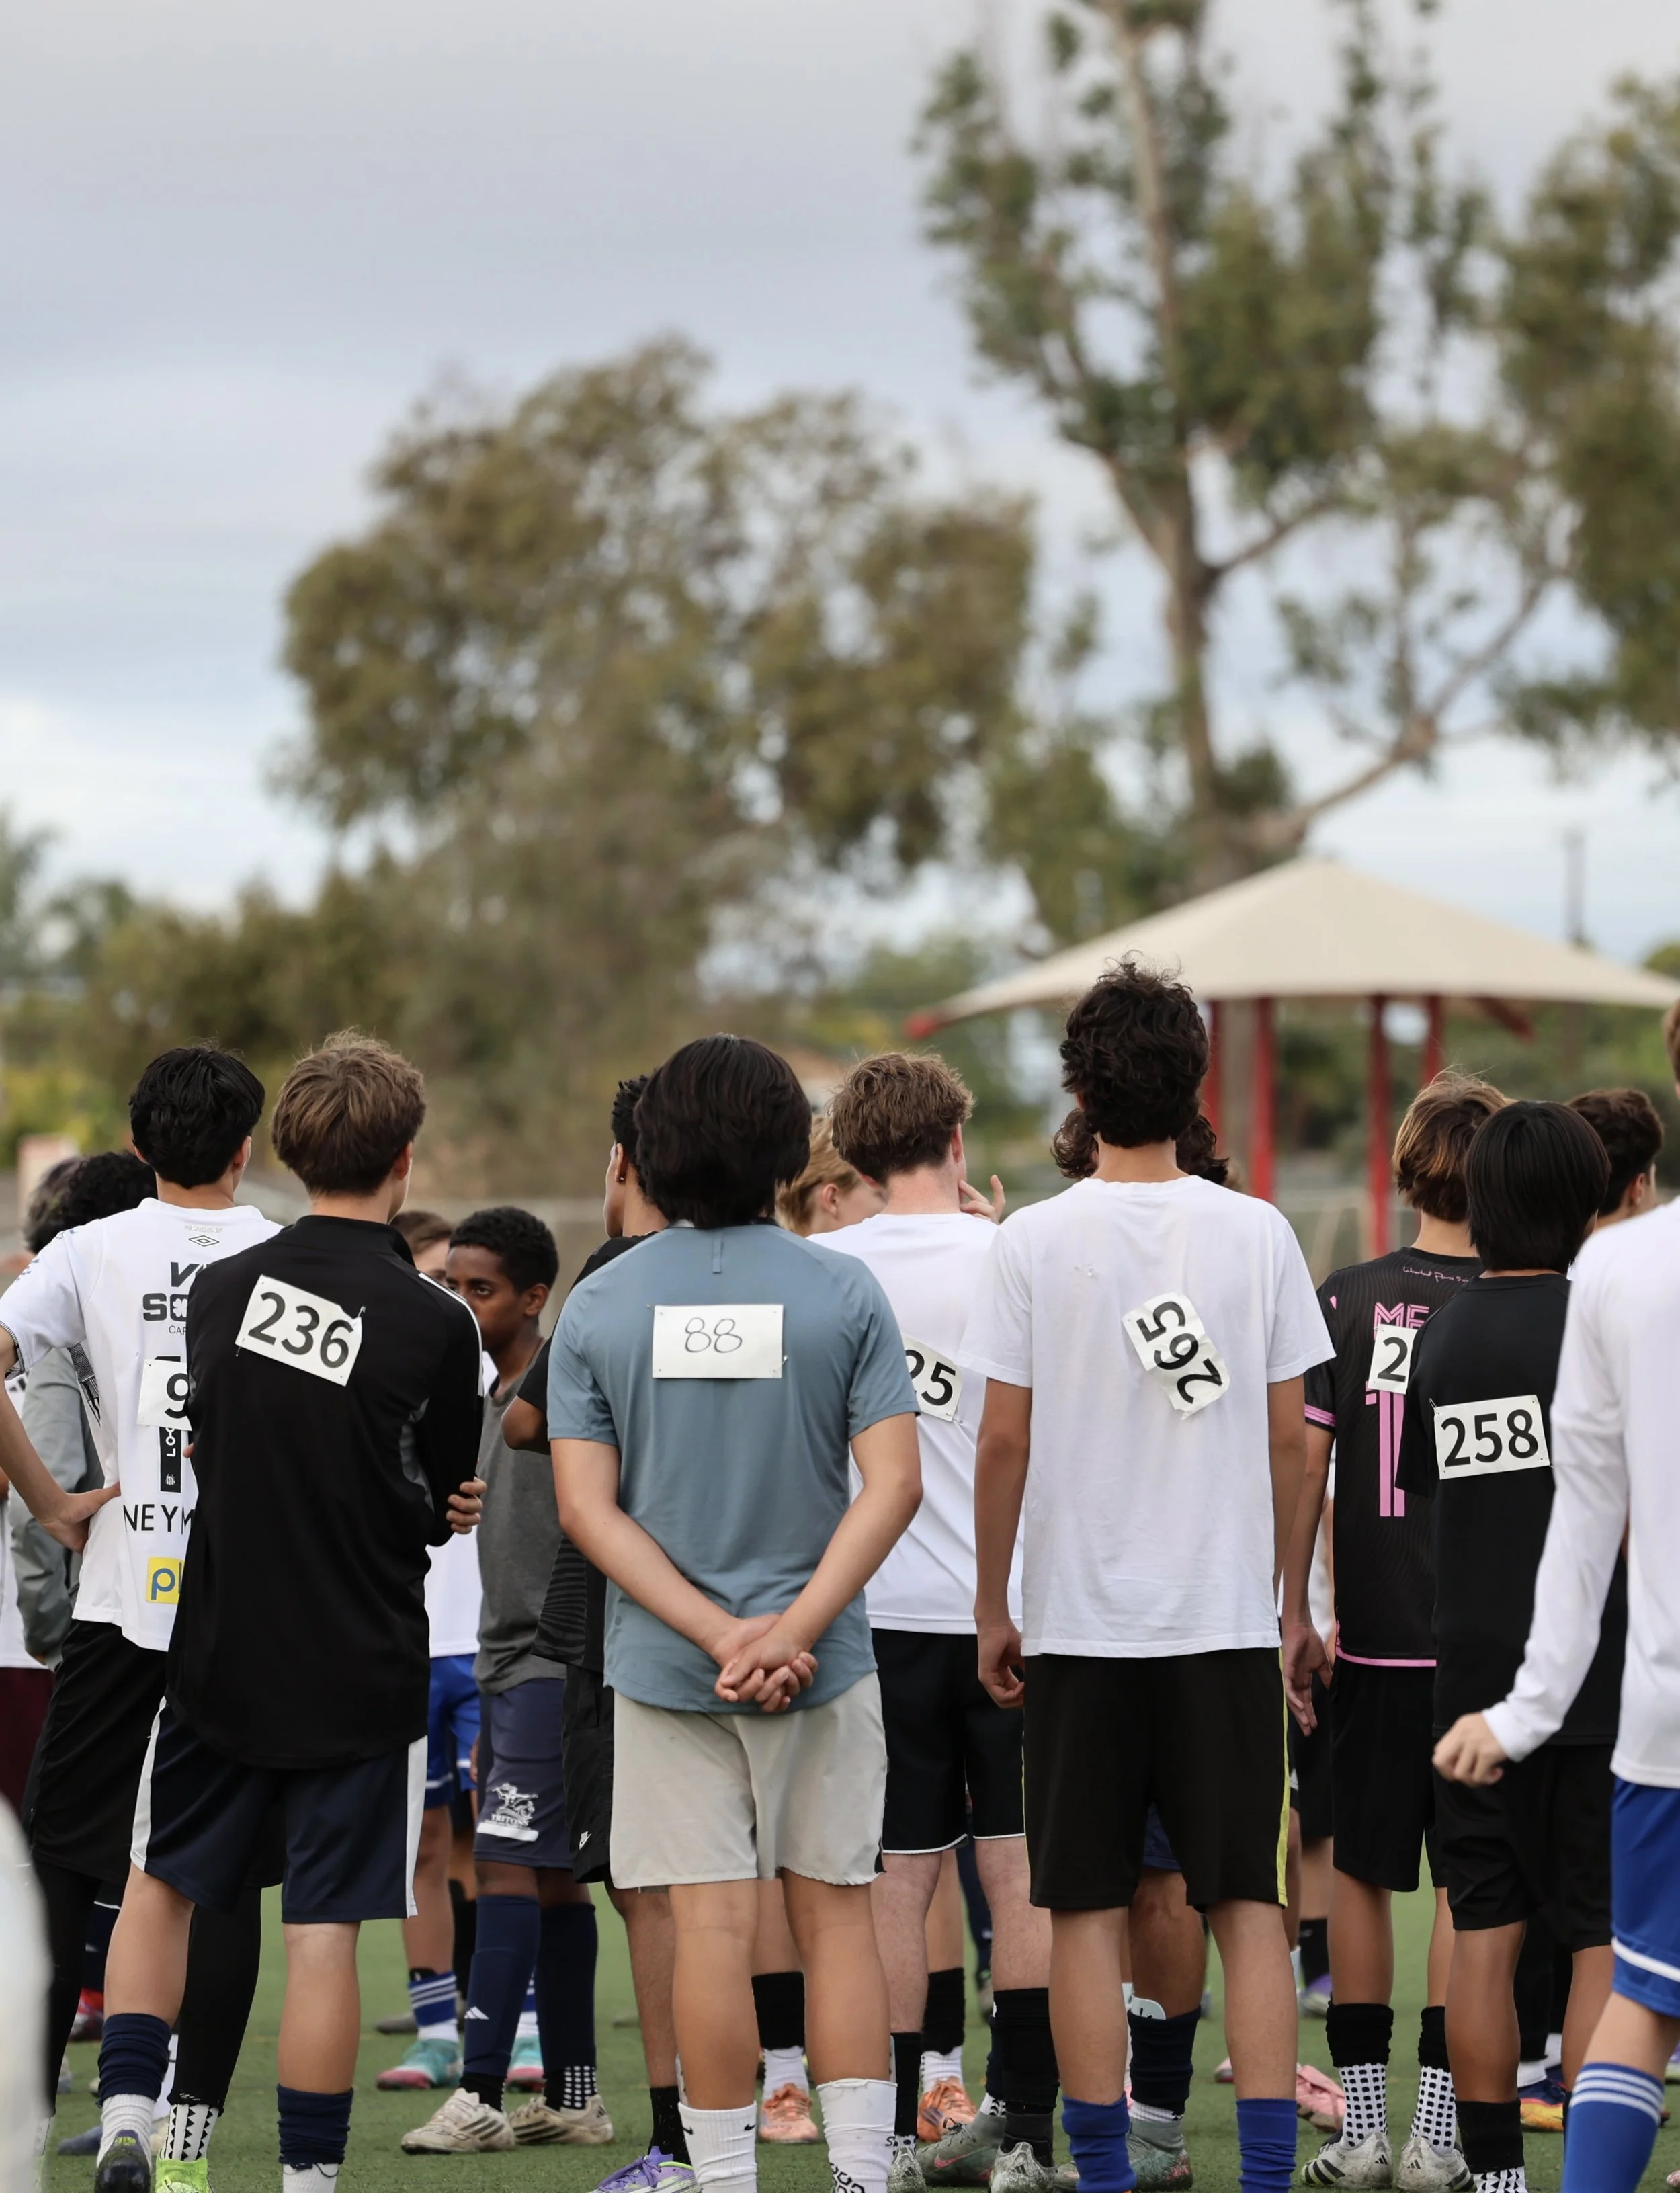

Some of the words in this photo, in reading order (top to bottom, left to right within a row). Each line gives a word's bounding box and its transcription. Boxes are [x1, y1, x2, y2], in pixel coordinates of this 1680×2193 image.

[248, 1292, 353, 1368] 236
[685, 1318, 743, 1353] 88
[1136, 1301, 1223, 1404] 265
[1441, 1409, 1539, 1467] 258
